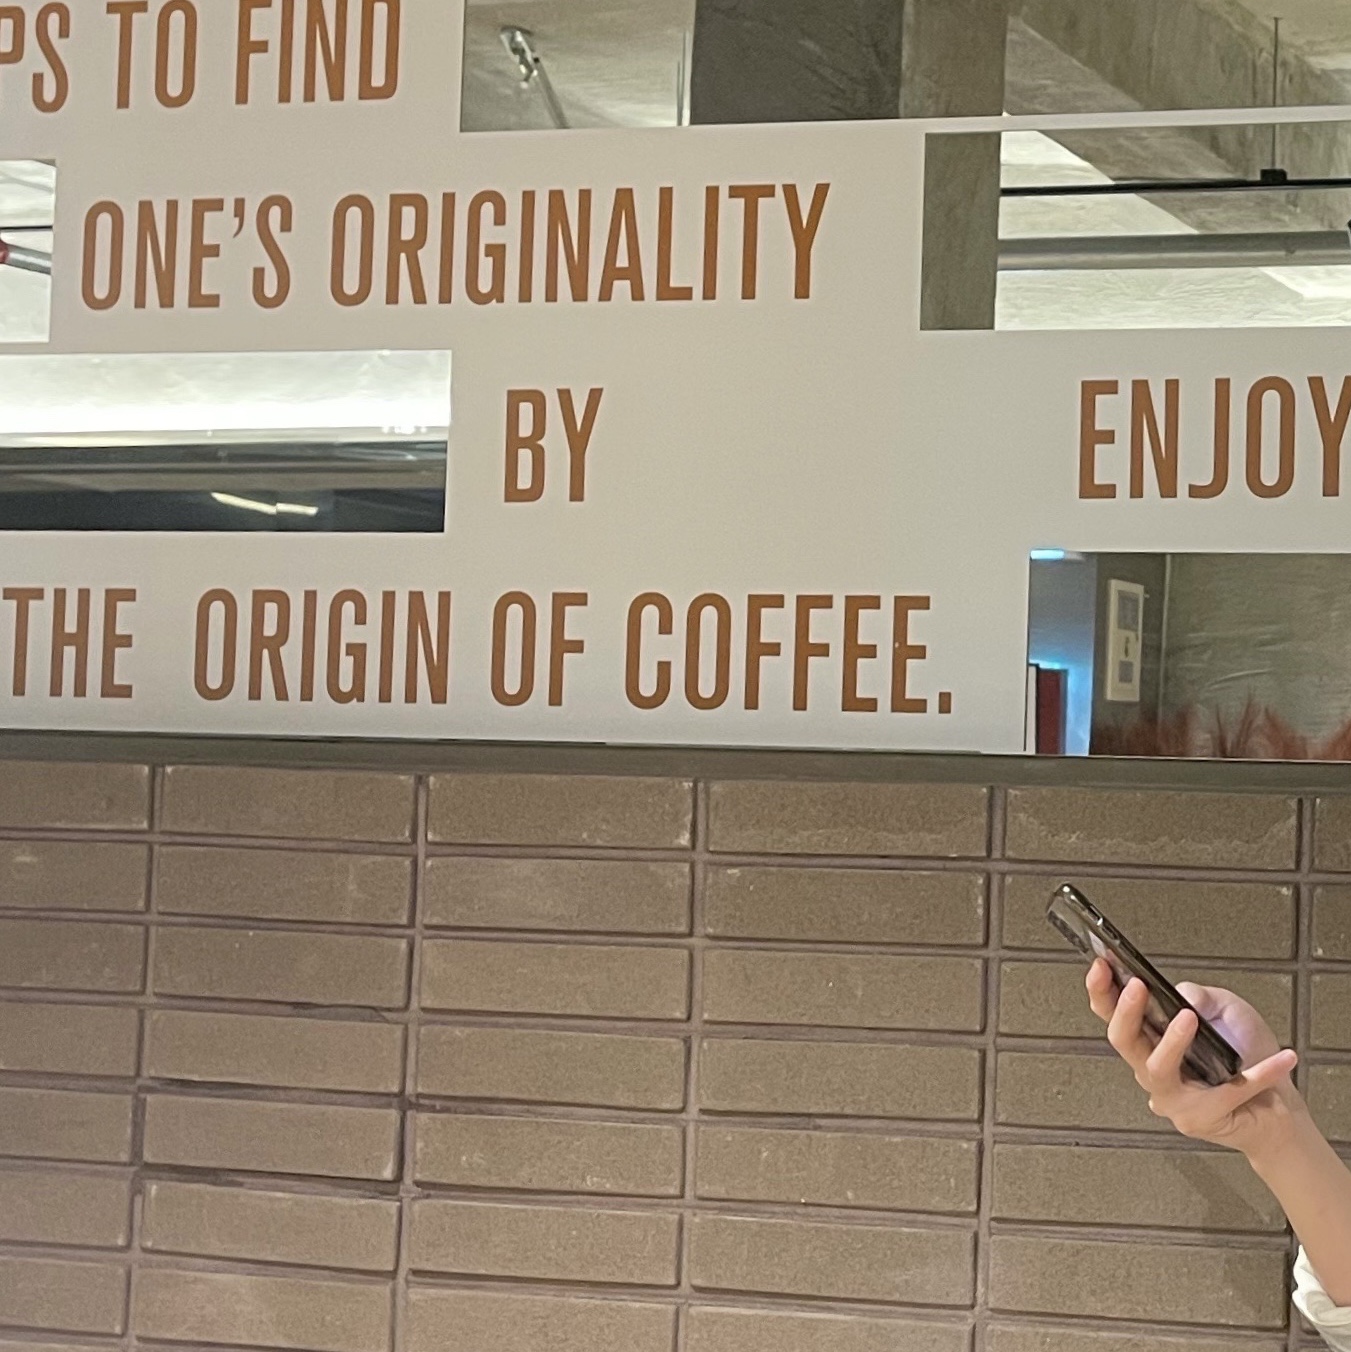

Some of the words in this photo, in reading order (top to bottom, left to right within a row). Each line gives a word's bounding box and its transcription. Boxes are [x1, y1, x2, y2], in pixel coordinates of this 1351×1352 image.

[106, 0, 198, 108] TO
[235, 0, 402, 104] FIND
[82, 195, 293, 310] ONE'S
[330, 182, 831, 306] ORIGINALITY
[503, 387, 603, 503] BY
[3, 587, 137, 699] THE
[194, 588, 452, 704] ORIGIN
[491, 591, 589, 706] OF
[625, 591, 952, 714] COFFEE.
